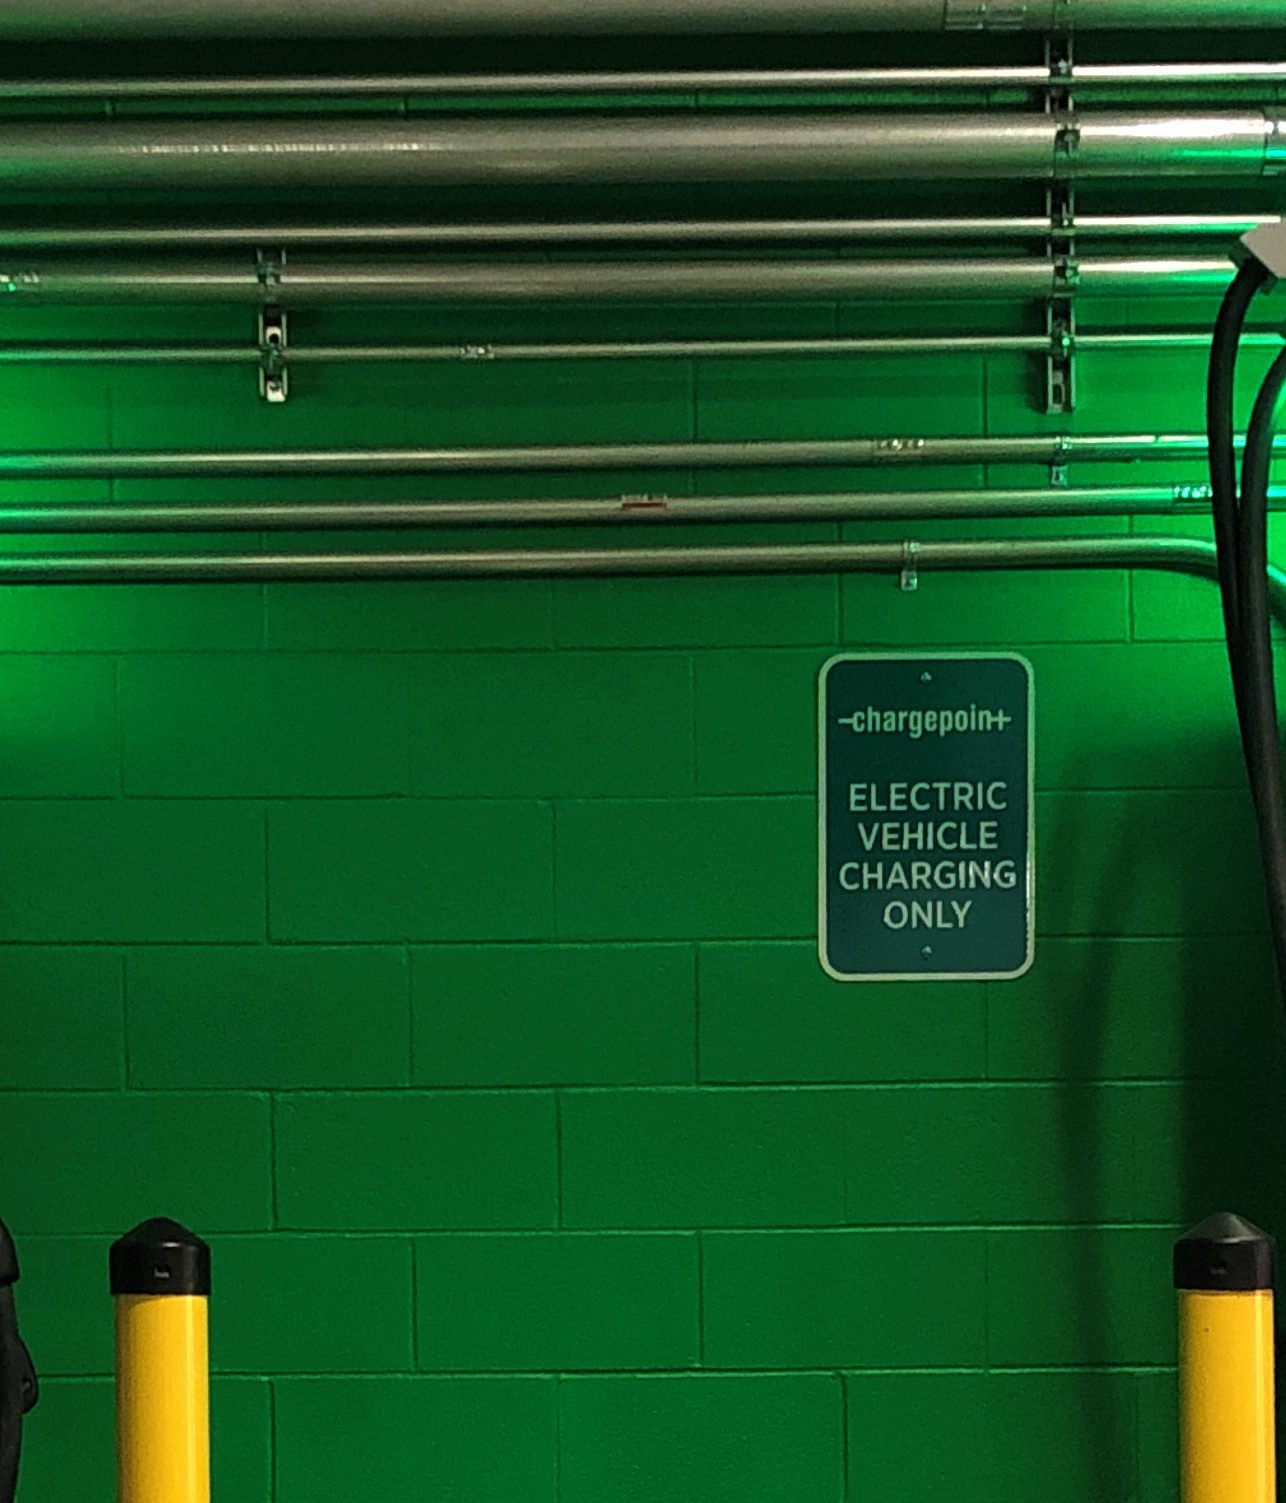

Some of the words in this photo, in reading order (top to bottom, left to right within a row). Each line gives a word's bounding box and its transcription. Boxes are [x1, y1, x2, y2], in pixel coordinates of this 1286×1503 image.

[849, 781, 1007, 812] ELECTRIC
[858, 821, 998, 850] VEHICLE
[839, 860, 1017, 890] CHARGING
[883, 900, 972, 929] ONLY
